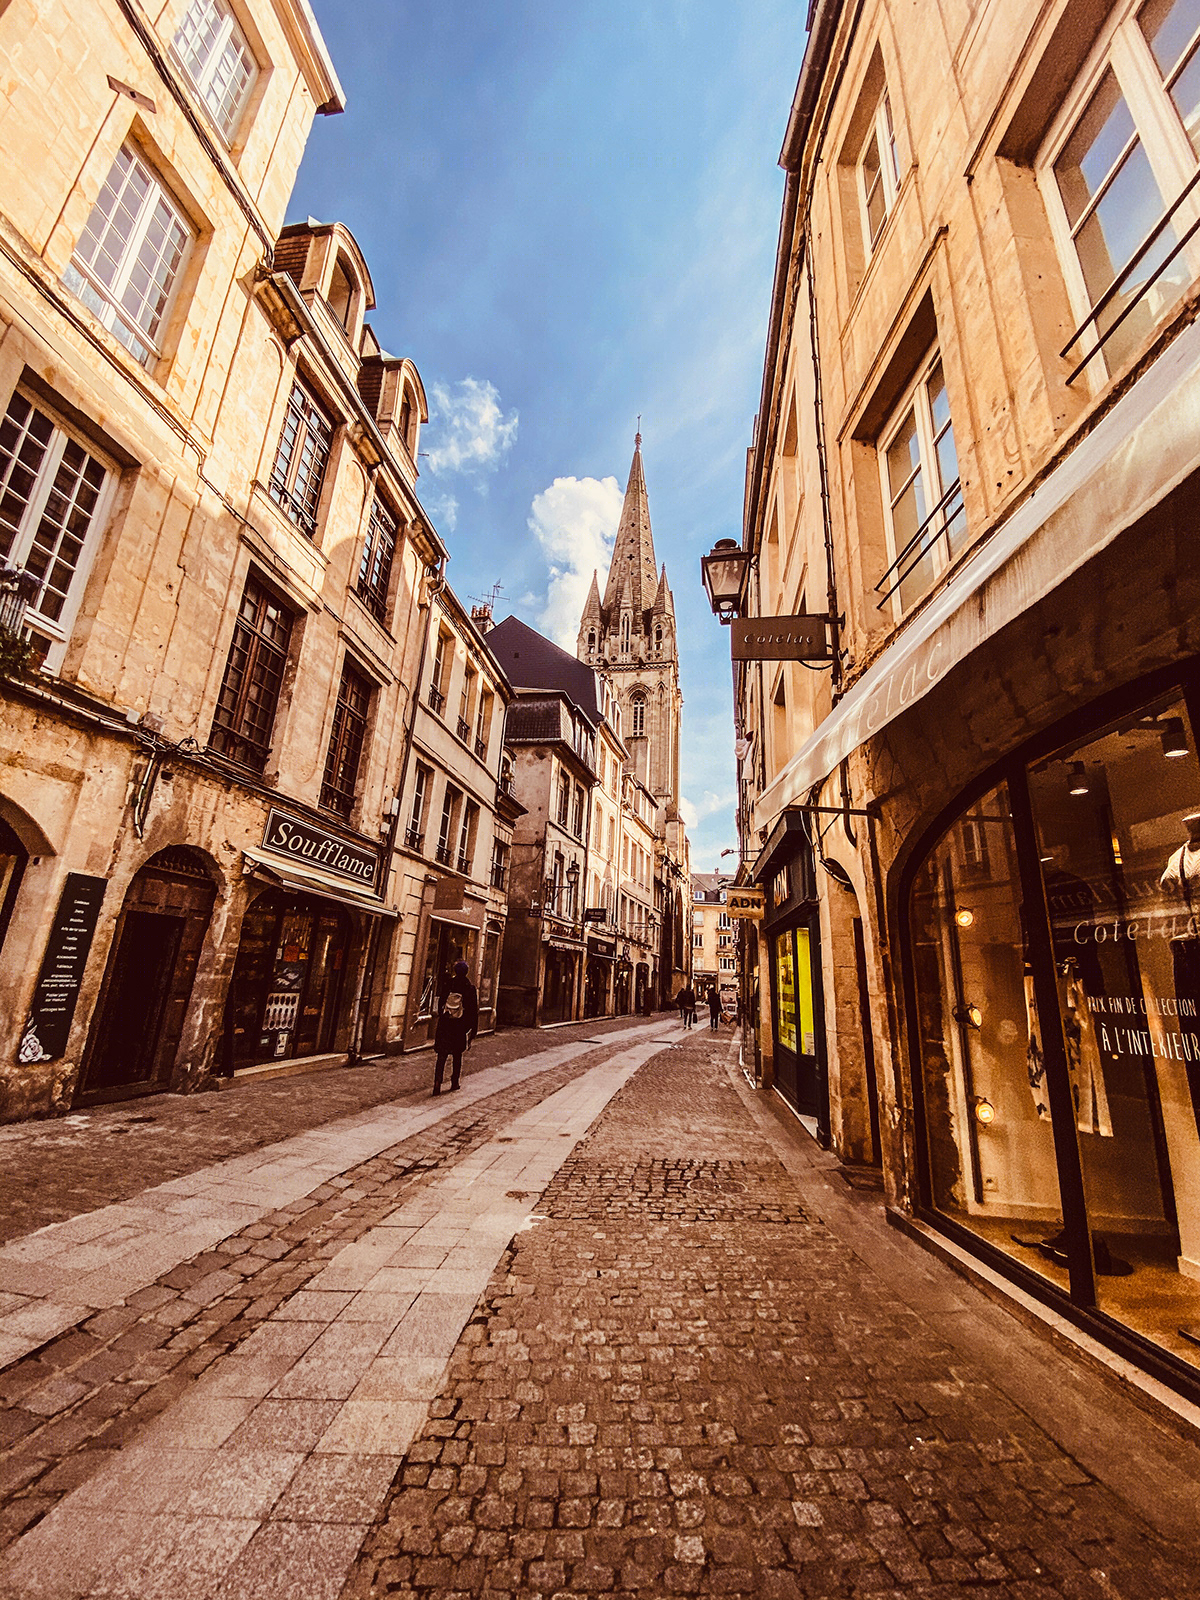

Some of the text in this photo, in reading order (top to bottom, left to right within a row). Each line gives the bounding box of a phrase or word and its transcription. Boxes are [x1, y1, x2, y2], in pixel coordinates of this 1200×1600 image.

[743, 633, 815, 645] Cotelac
[270, 822, 373, 878] Soufflame
[773, 865, 789, 909] ADN
[729, 897, 762, 909] ADN
[1108, 997, 1124, 1014] FIN
[1125, 997, 1138, 1015] DE
[1101, 1022, 1112, 1052] À
